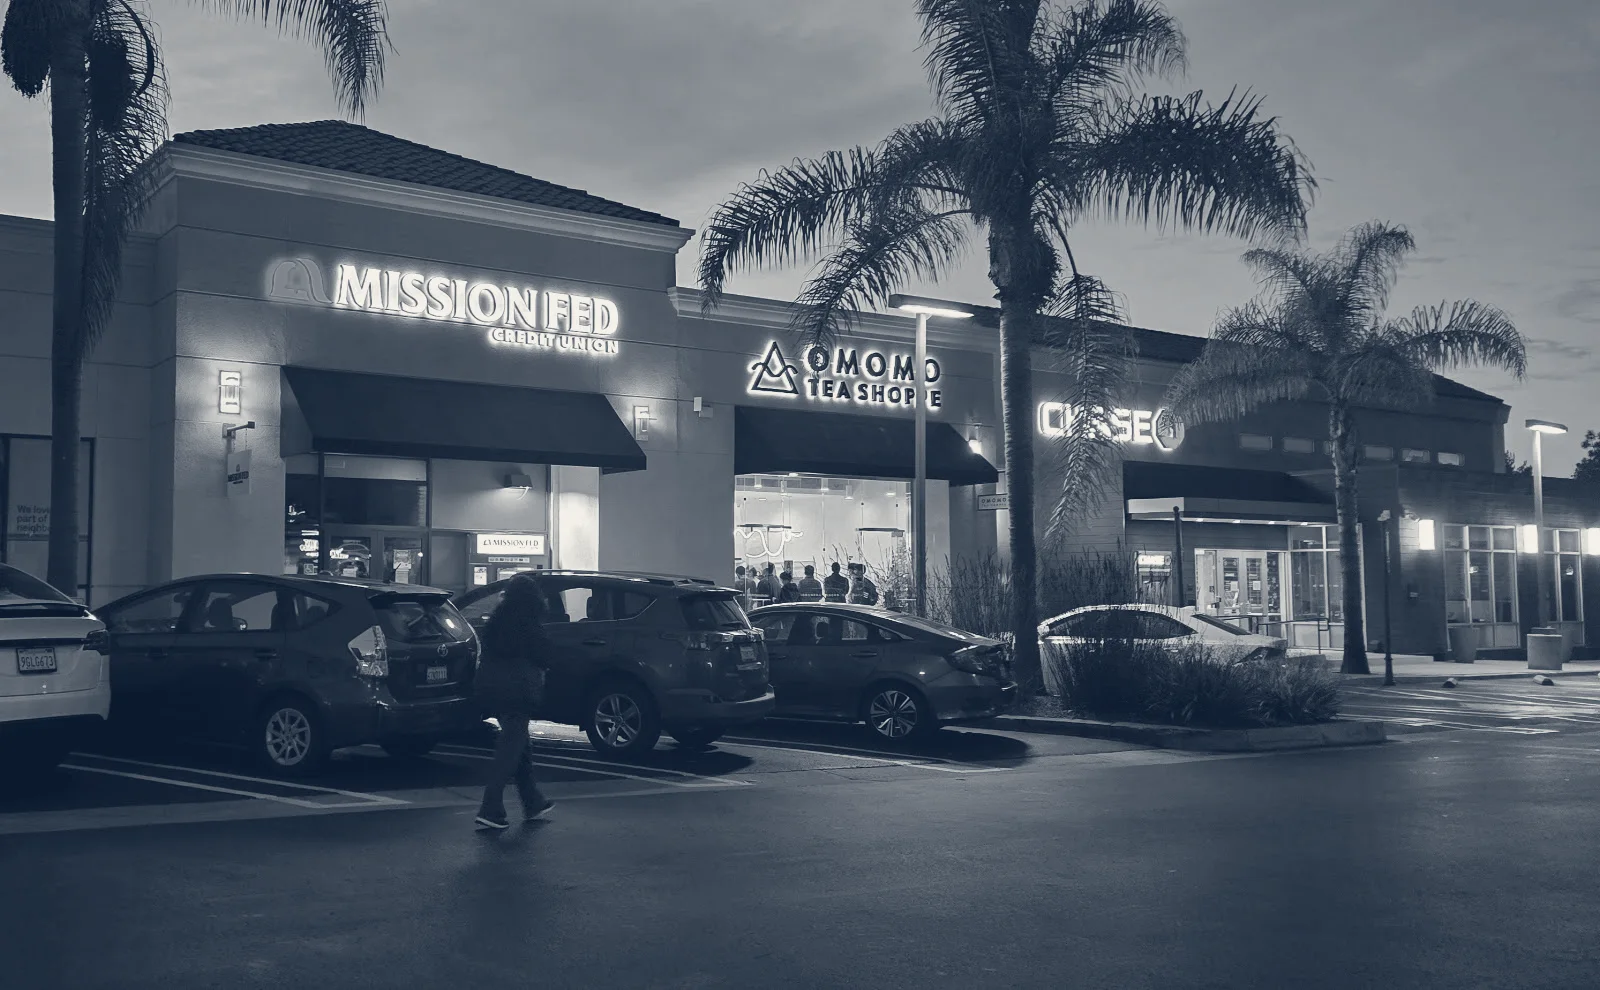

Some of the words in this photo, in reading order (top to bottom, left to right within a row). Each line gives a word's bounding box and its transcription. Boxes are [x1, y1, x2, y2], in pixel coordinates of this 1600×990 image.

[336, 264, 539, 328] MISSION
[545, 290, 619, 336] FED
[492, 327, 556, 348] CREDIT
[557, 334, 620, 354] UNION
[807, 345, 941, 383] OMOMO
[807, 378, 851, 399] TEA
[857, 383, 942, 407] SHOPE
[16, 515, 36, 523] part
[38, 514, 48, 522] of
[17, 505, 31, 513] We
[16, 524, 50, 534] neighb
